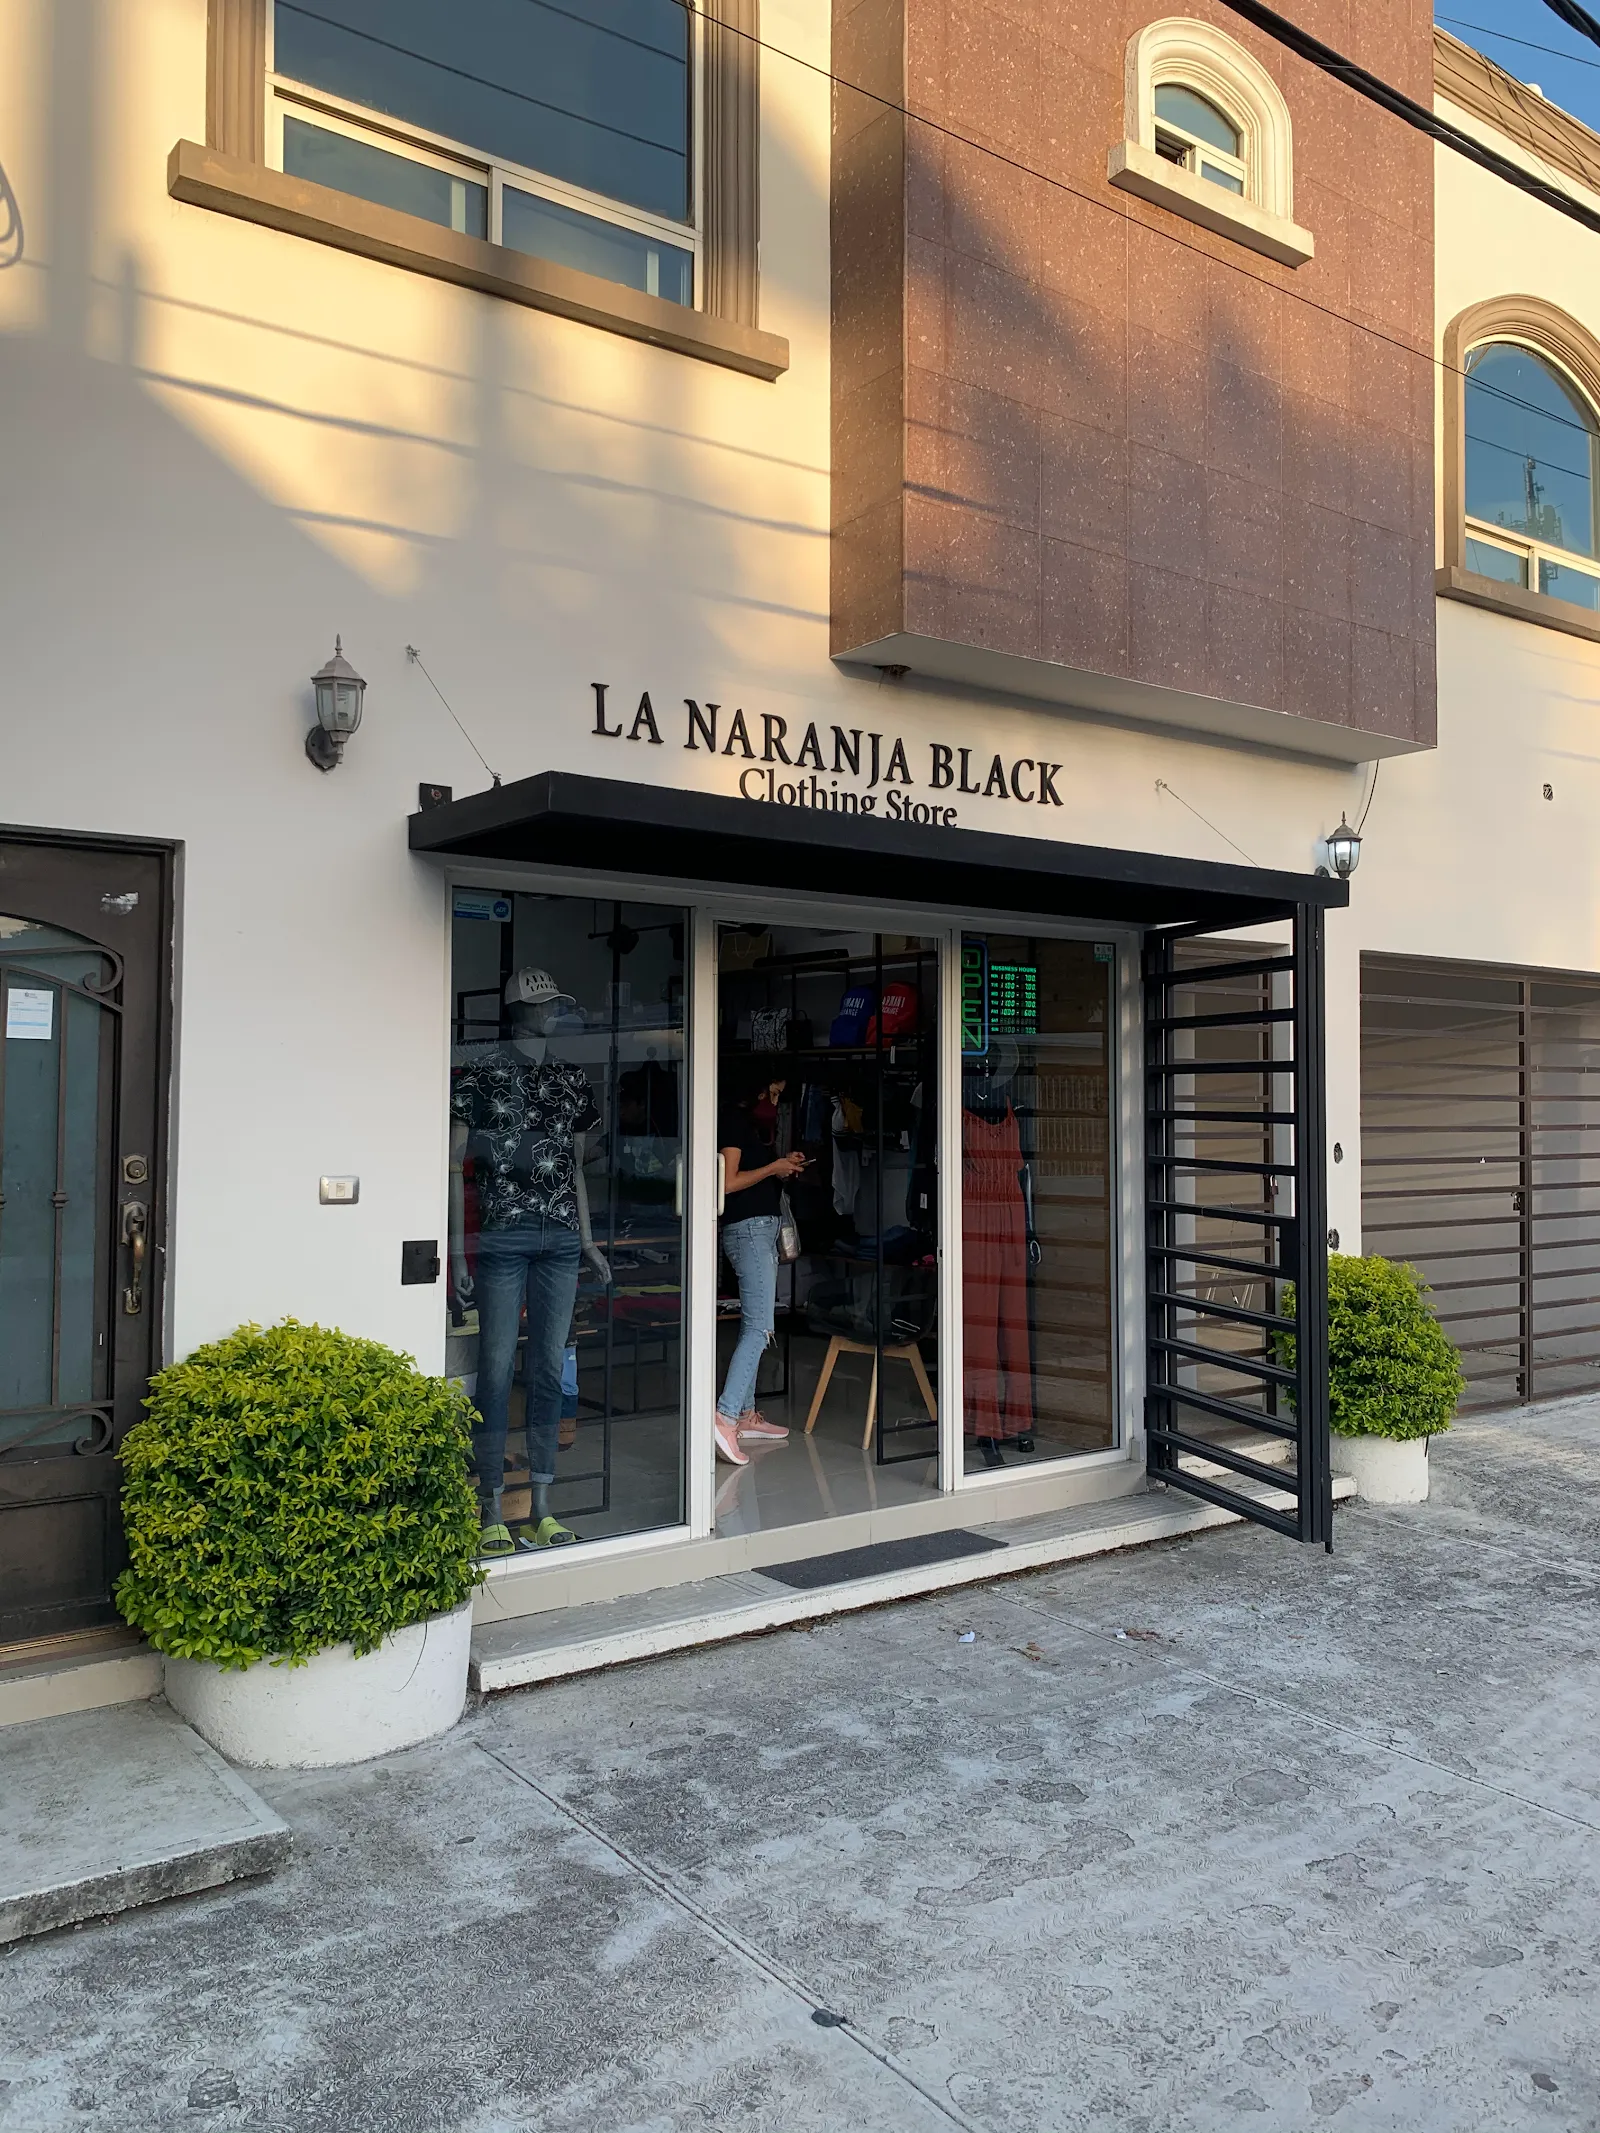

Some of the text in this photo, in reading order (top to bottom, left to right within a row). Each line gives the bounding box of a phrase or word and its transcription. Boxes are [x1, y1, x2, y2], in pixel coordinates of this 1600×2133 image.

[591, 683, 1064, 806] LA NARANJA BLACK
[739, 767, 958, 828] Clothing Store
[961, 948, 982, 1048] OPEN
